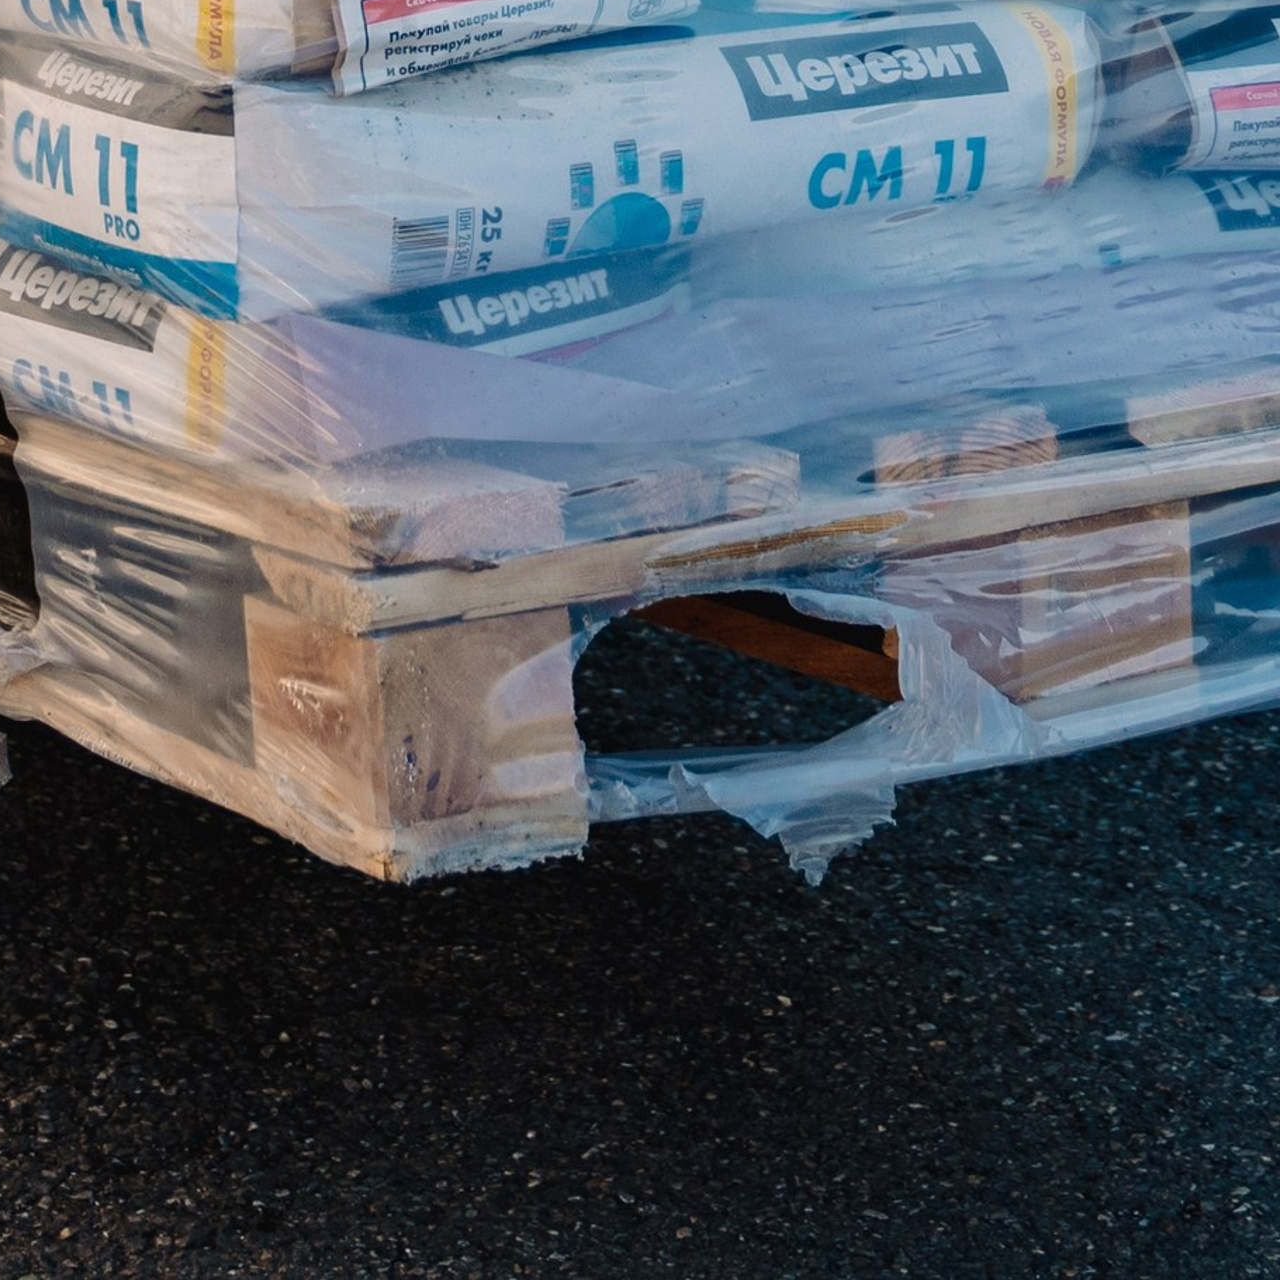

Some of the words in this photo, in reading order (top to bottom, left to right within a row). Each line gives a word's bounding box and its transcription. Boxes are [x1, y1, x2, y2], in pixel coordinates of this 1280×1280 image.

[384, 34, 472, 61] регистрируй
[473, 27, 504, 45] чеки
[389, 19, 450, 45] Покупай
[452, 9, 500, 33] товары
[37, 50, 145, 107] Церезит
[744, 42, 983, 102] Церезит
[1021, 10, 1062, 63] НОВАЯ
[1054, 68, 1069, 169] ФОРМУЛА
[94, 132, 140, 215] 11
[933, 136, 987, 194] 11
[102, 212, 142, 242] PRO
[458, 210, 473, 233] IDH
[481, 206, 503, 243] 25
[438, 268, 610, 338] Церезит
